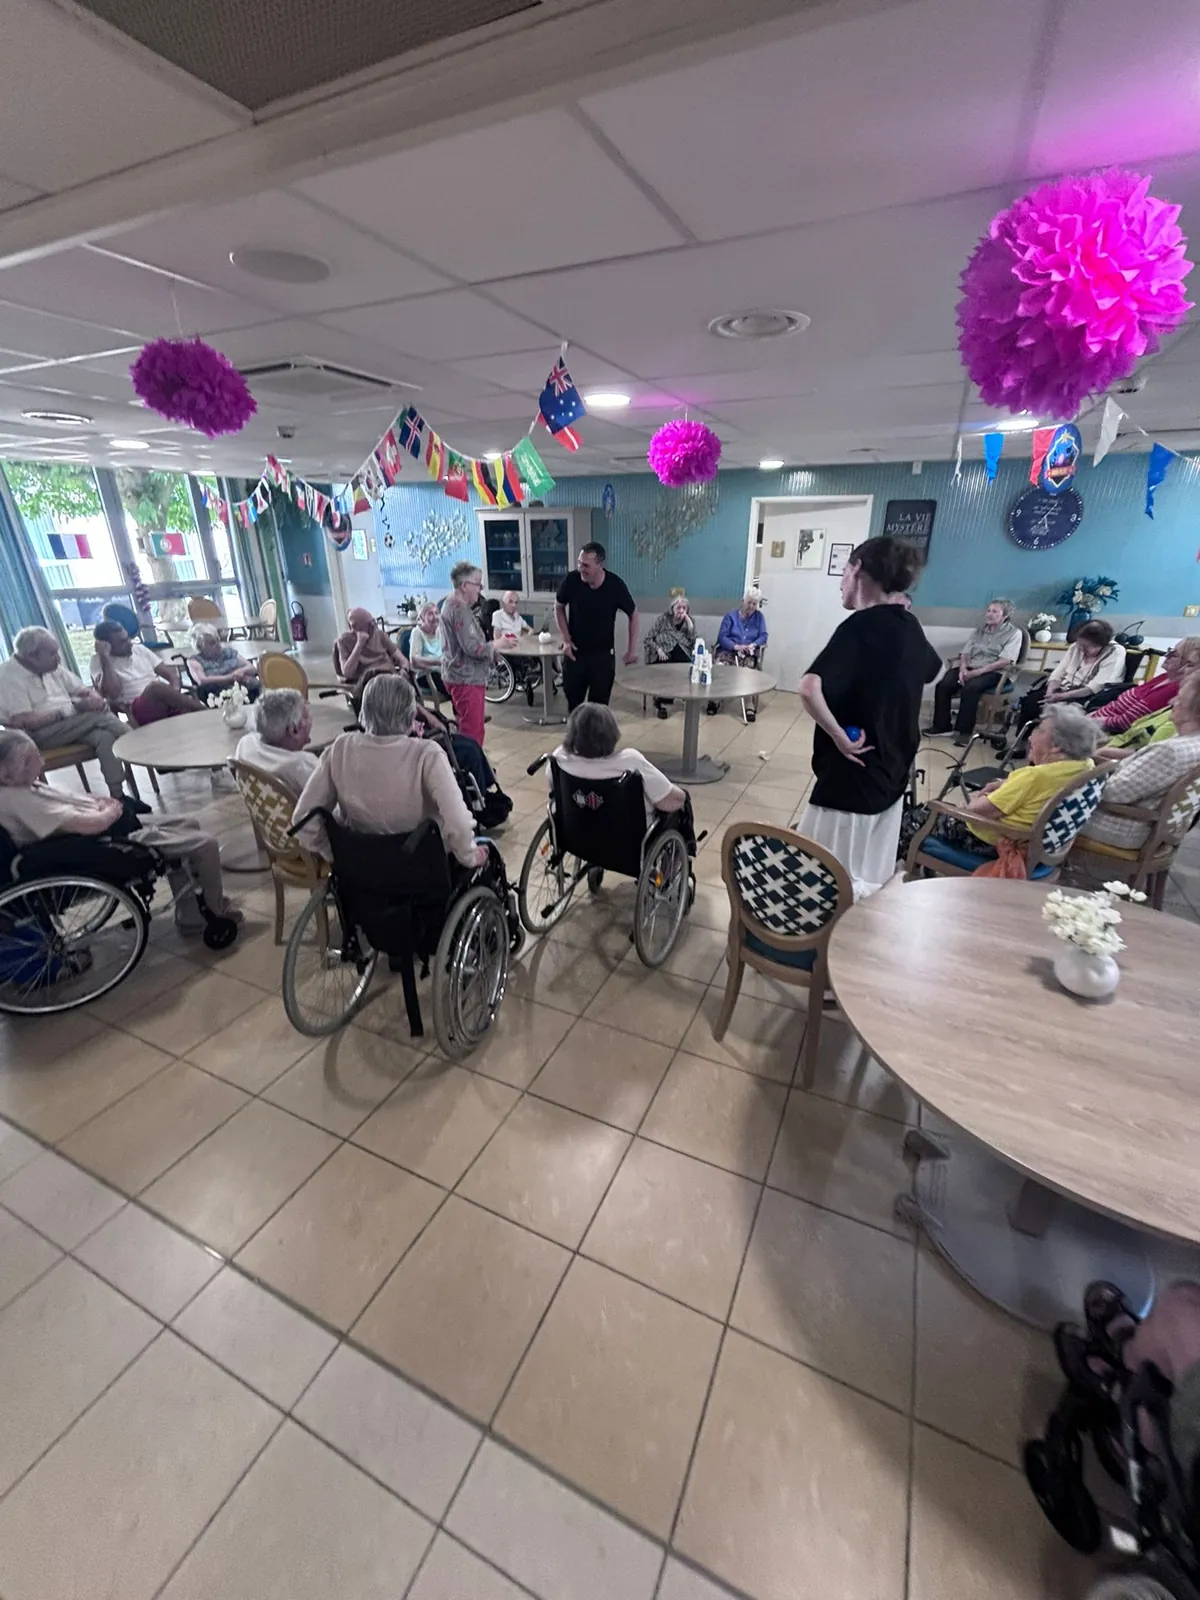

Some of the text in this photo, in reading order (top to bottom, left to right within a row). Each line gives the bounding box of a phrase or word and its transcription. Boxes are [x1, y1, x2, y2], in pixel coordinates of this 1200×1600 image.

[899, 512, 931, 521] LA VIE
[1016, 509, 1022, 517] 9
[1070, 513, 1077, 522] 3
[1033, 536, 1040, 545] 6
